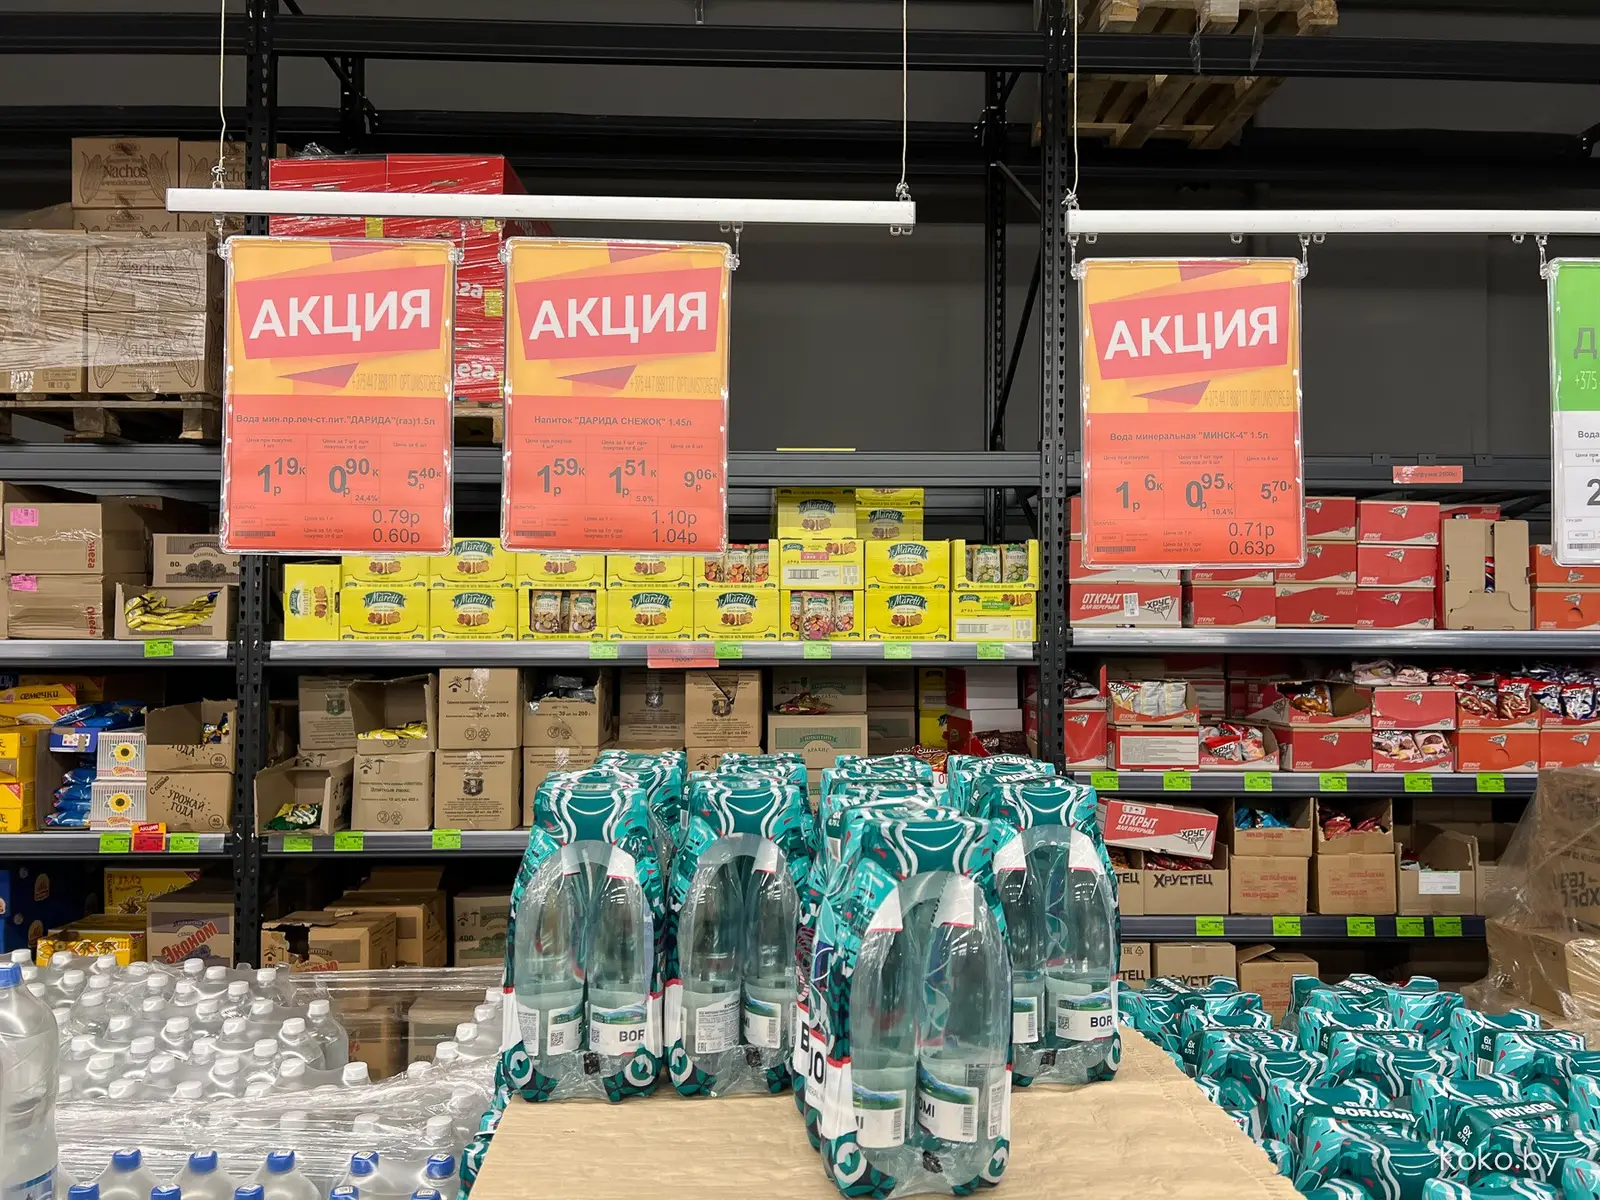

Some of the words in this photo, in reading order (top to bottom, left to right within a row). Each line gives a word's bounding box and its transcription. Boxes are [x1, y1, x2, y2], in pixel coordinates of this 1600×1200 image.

[102, 164, 148, 178] Nachos
[249, 289, 431, 342] АКЦИЯ
[528, 291, 707, 343] АКЦИЯ
[1104, 305, 1278, 360] АКЦИЯ
[236, 415, 259, 424] Вода
[534, 415, 573, 424] Напиток
[575, 416, 619, 425] "ДАРИДА
[621, 416, 666, 426] СНЕЖОК"
[669, 418, 692, 427] 1.45л
[1110, 433, 1133, 442] Вода
[1135, 432, 1196, 441] минеральная
[1198, 431, 1248, 440] "МИНСК-4"
[1250, 431, 1269, 440] 1.5л
[372, 509, 420, 527] 0.79р
[652, 509, 697, 527] 1.10р
[372, 528, 420, 545] 0.60р
[652, 528, 698, 545] 1.04р
[1228, 522, 1275, 540] 0.71р
[457, 540, 489, 552] Maretti
[895, 544, 922, 557] Maretti
[1228, 540, 1275, 557] 0.63р
[369, 592, 401, 604] Maretti
[457, 593, 490, 605] Maretti
[637, 593, 666, 605] Maretti
[723, 593, 752, 605] Maretti
[894, 595, 921, 607] Maretti
[1081, 593, 1122, 605] ОТКРЫТ
[1146, 597, 1171, 610] ХРУС
[167, 789, 206, 812] УРОЖАЙ
[171, 801, 194, 818] ГОДА
[1118, 813, 1159, 829] ОТКРЫТ
[1127, 826, 1156, 836] ПЕРЕРЫВА
[1181, 828, 1206, 839] ХРУС
[1153, 873, 1213, 888] ХРУСТЕЦ
[1331, 1106, 1416, 1123] BORJOMI
[1486, 1102, 1558, 1120] BORJOMI
